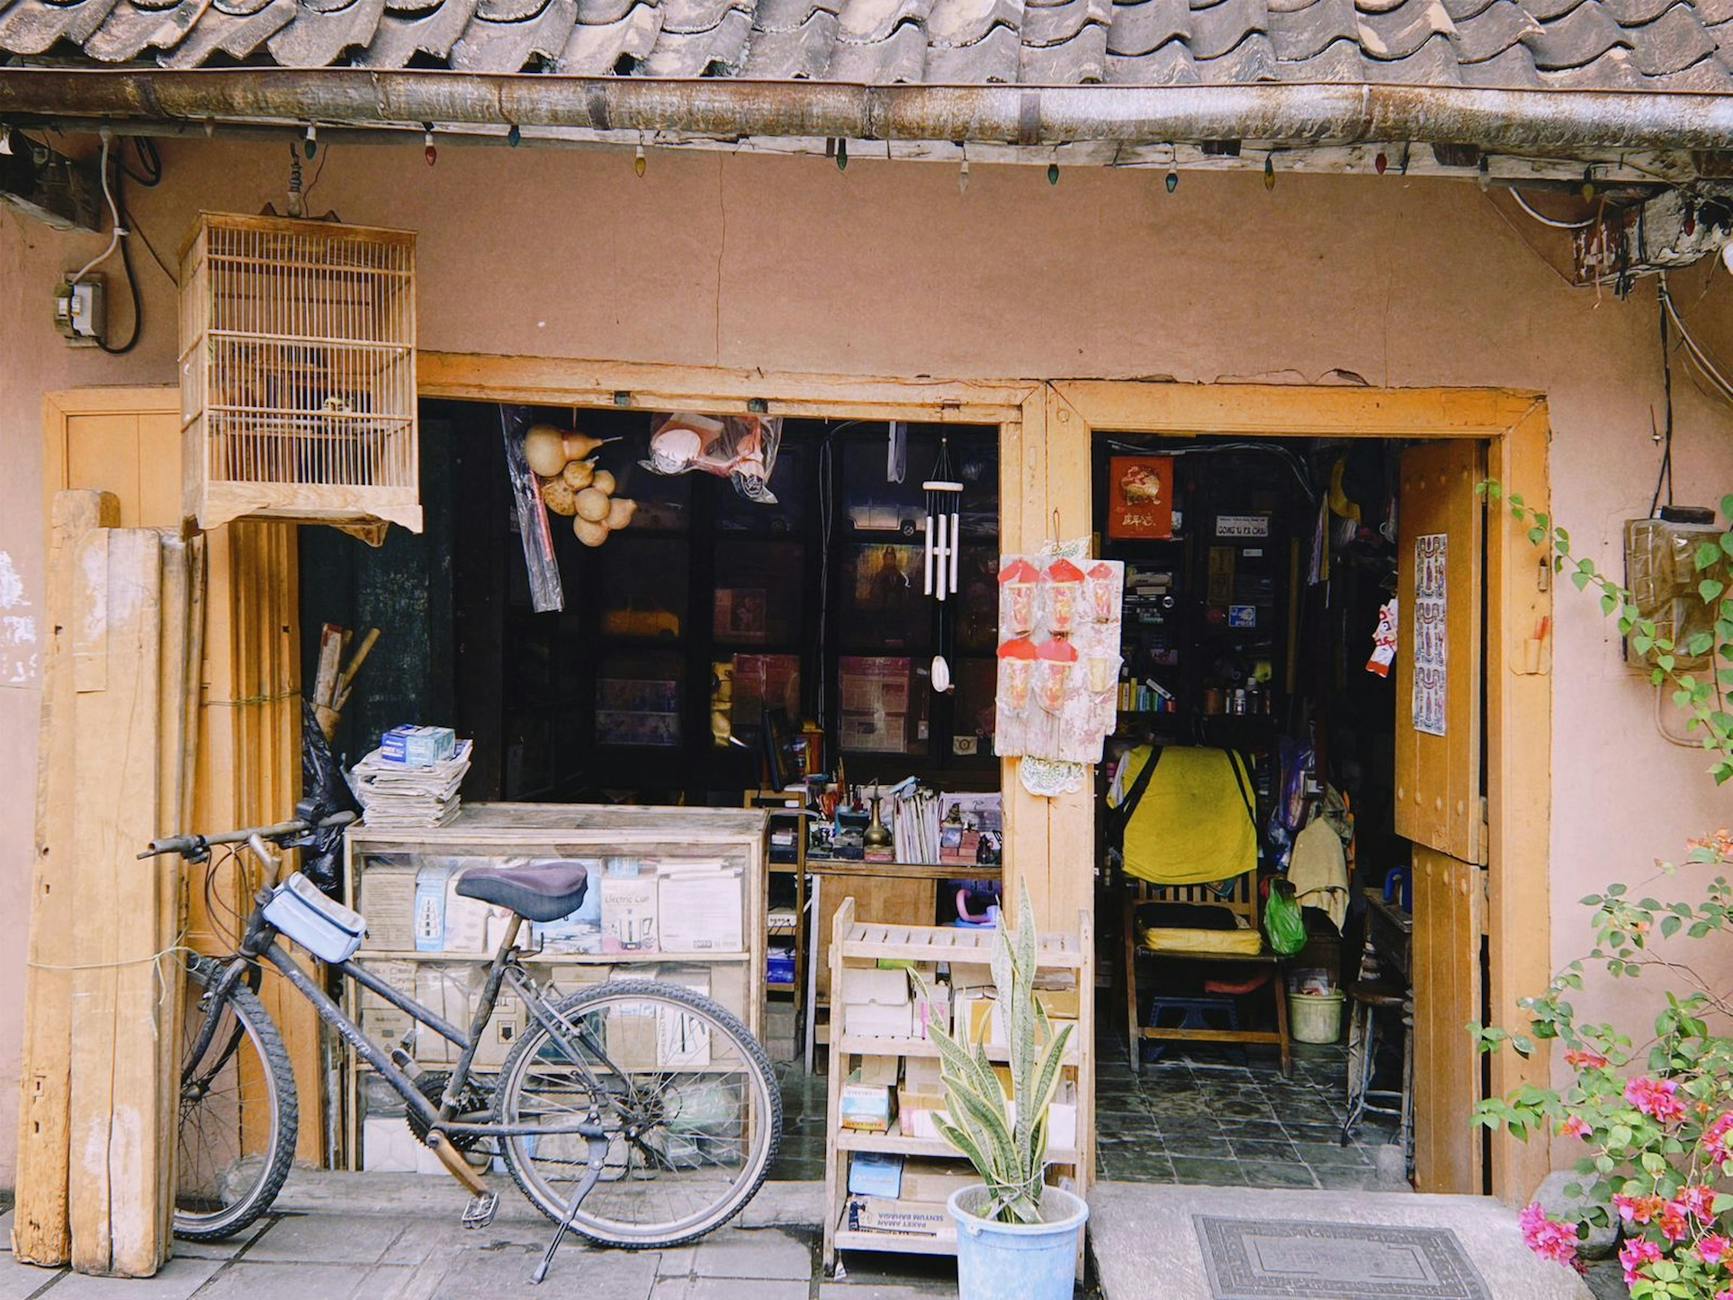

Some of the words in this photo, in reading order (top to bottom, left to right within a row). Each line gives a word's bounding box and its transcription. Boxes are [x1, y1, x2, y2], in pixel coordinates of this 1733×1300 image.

[604, 893, 633, 904] Electric
[878, 1212, 912, 1221] BAHAGIA
[913, 1213, 944, 1222] SENYUM
[877, 1219, 901, 1228] AMAN
[902, 1221, 927, 1229] PAKET
